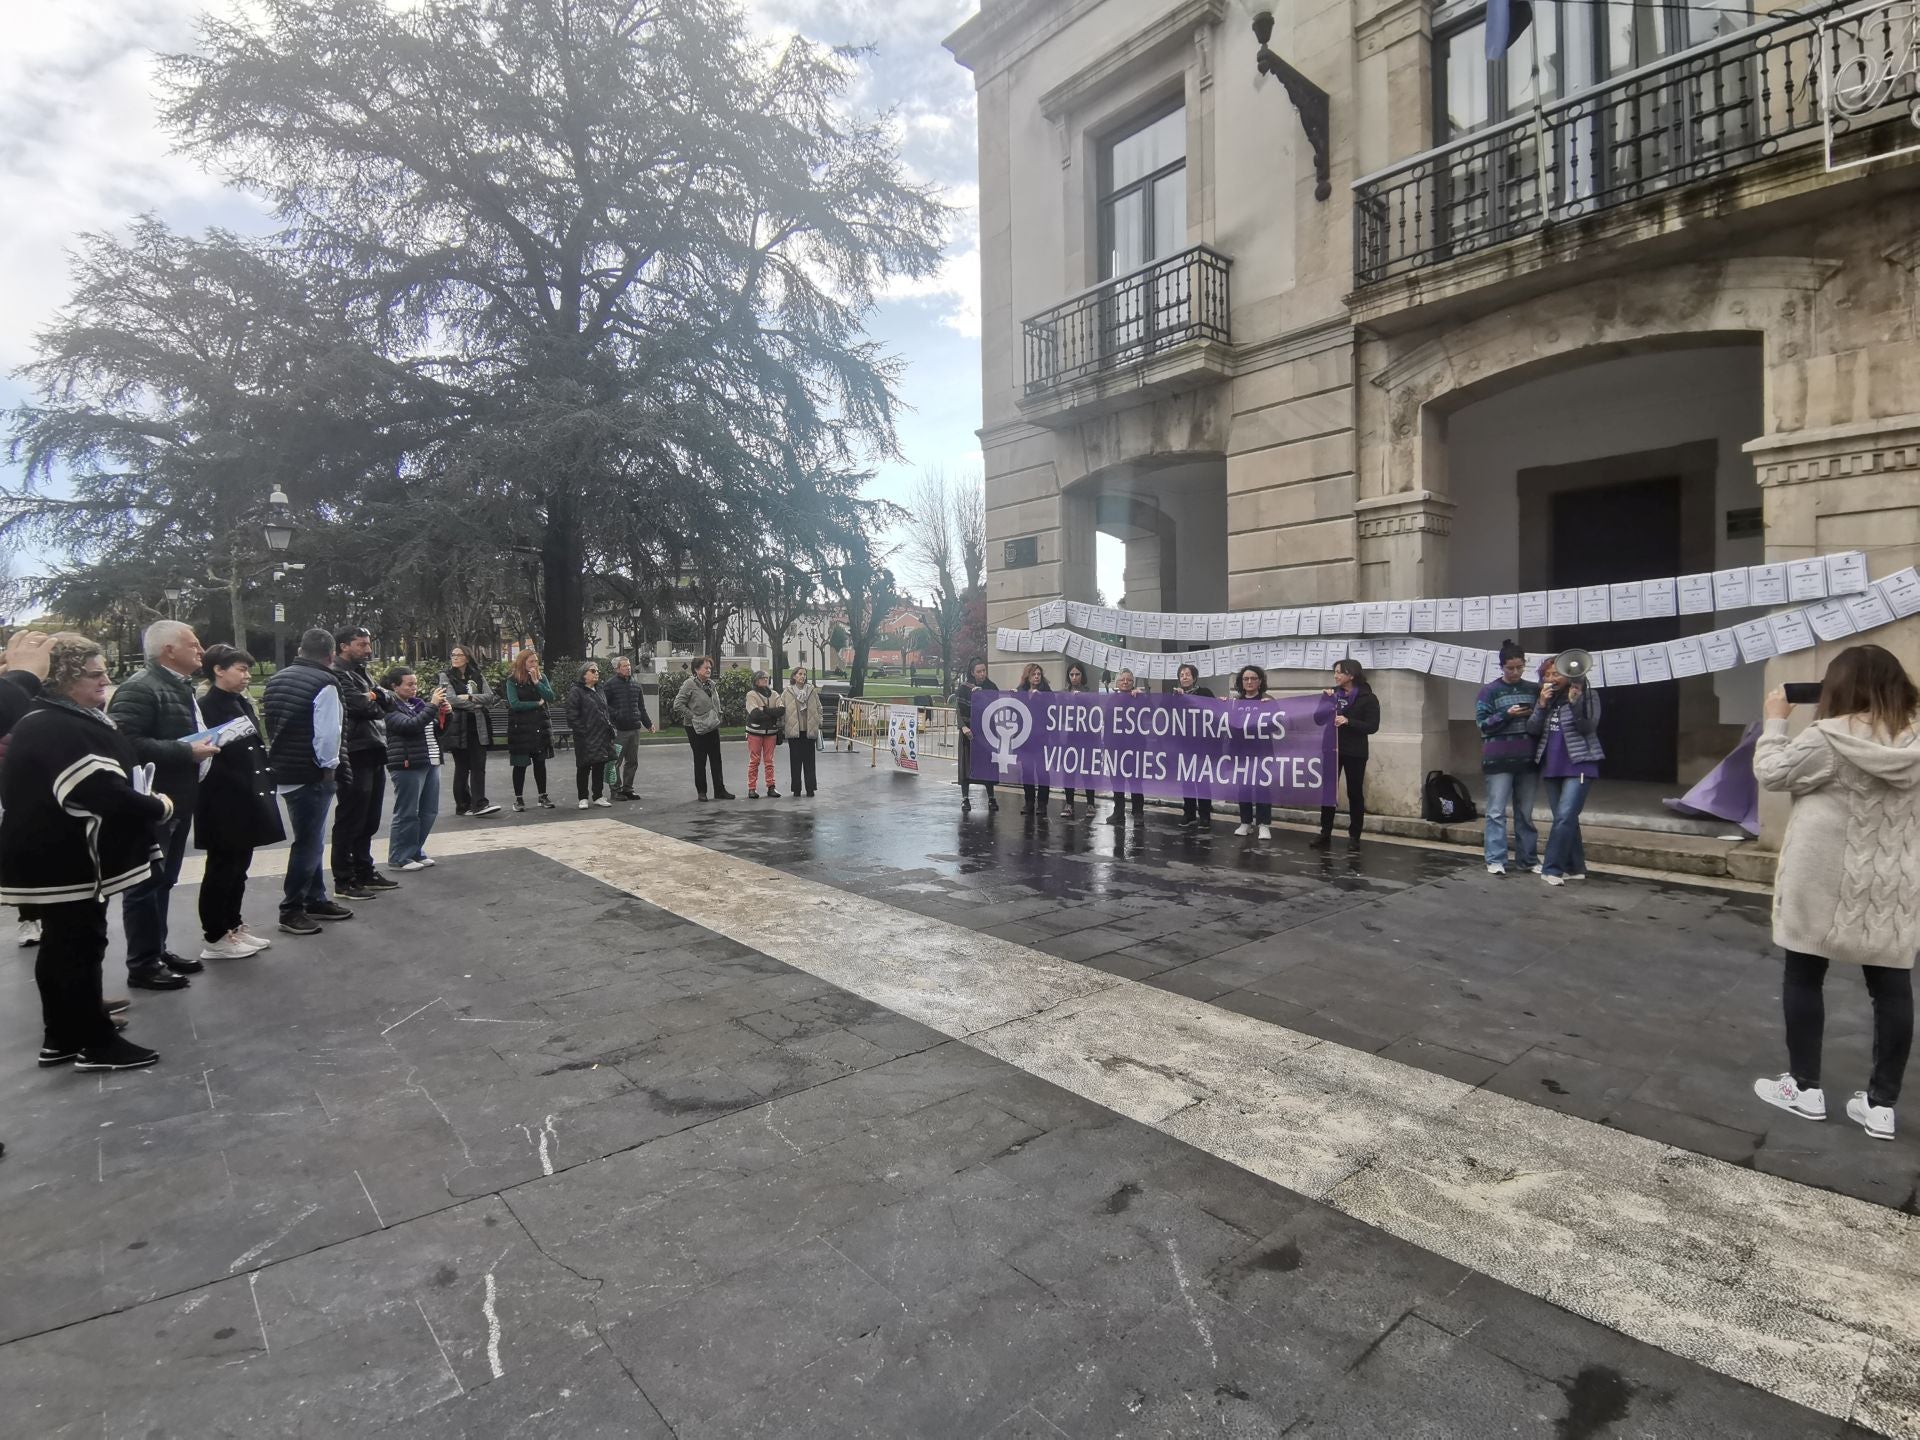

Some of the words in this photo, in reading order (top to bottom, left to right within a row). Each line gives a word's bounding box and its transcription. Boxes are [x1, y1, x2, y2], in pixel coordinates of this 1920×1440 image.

[1046, 705, 1104, 733] SIERO
[1113, 706, 1233, 739] ESCONTRA
[1243, 711, 1286, 740] LES
[1043, 745, 1167, 780] VIOLENCIES
[1177, 753, 1323, 788] MACHISTES
